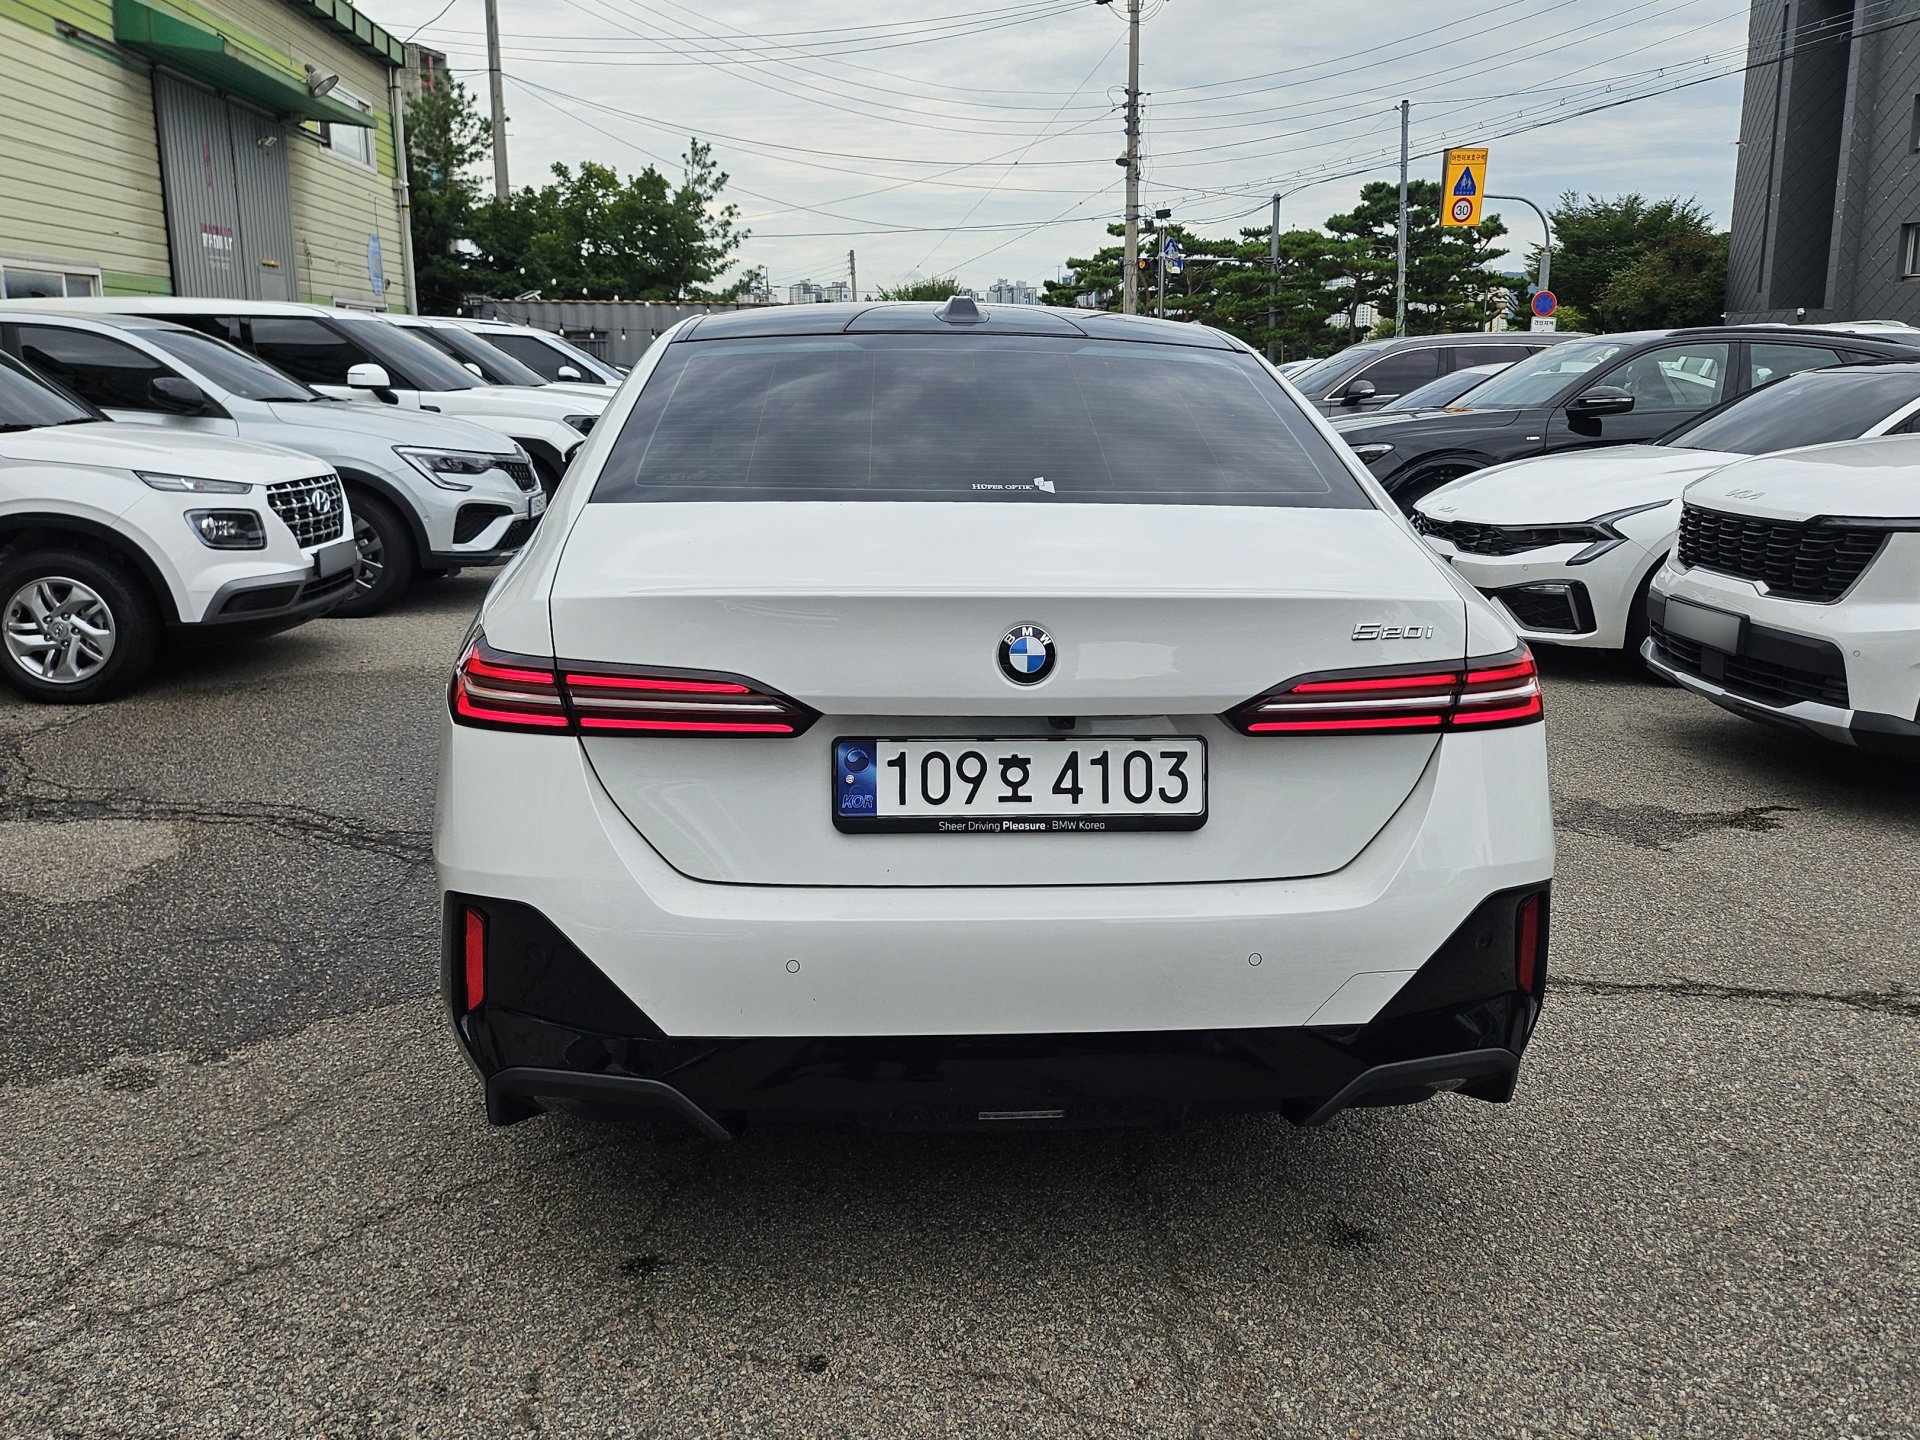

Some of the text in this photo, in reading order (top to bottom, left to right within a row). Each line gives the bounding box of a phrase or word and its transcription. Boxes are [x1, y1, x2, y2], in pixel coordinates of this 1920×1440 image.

[1455, 205, 1469, 216] 30
[1004, 626, 1052, 646] BMW
[1351, 622, 1434, 641] 520i
[887, 750, 1189, 806] 109호 4103
[841, 794, 874, 809] KOR
[938, 820, 1106, 833] Sheer Driving Pleasure BMW Korea
